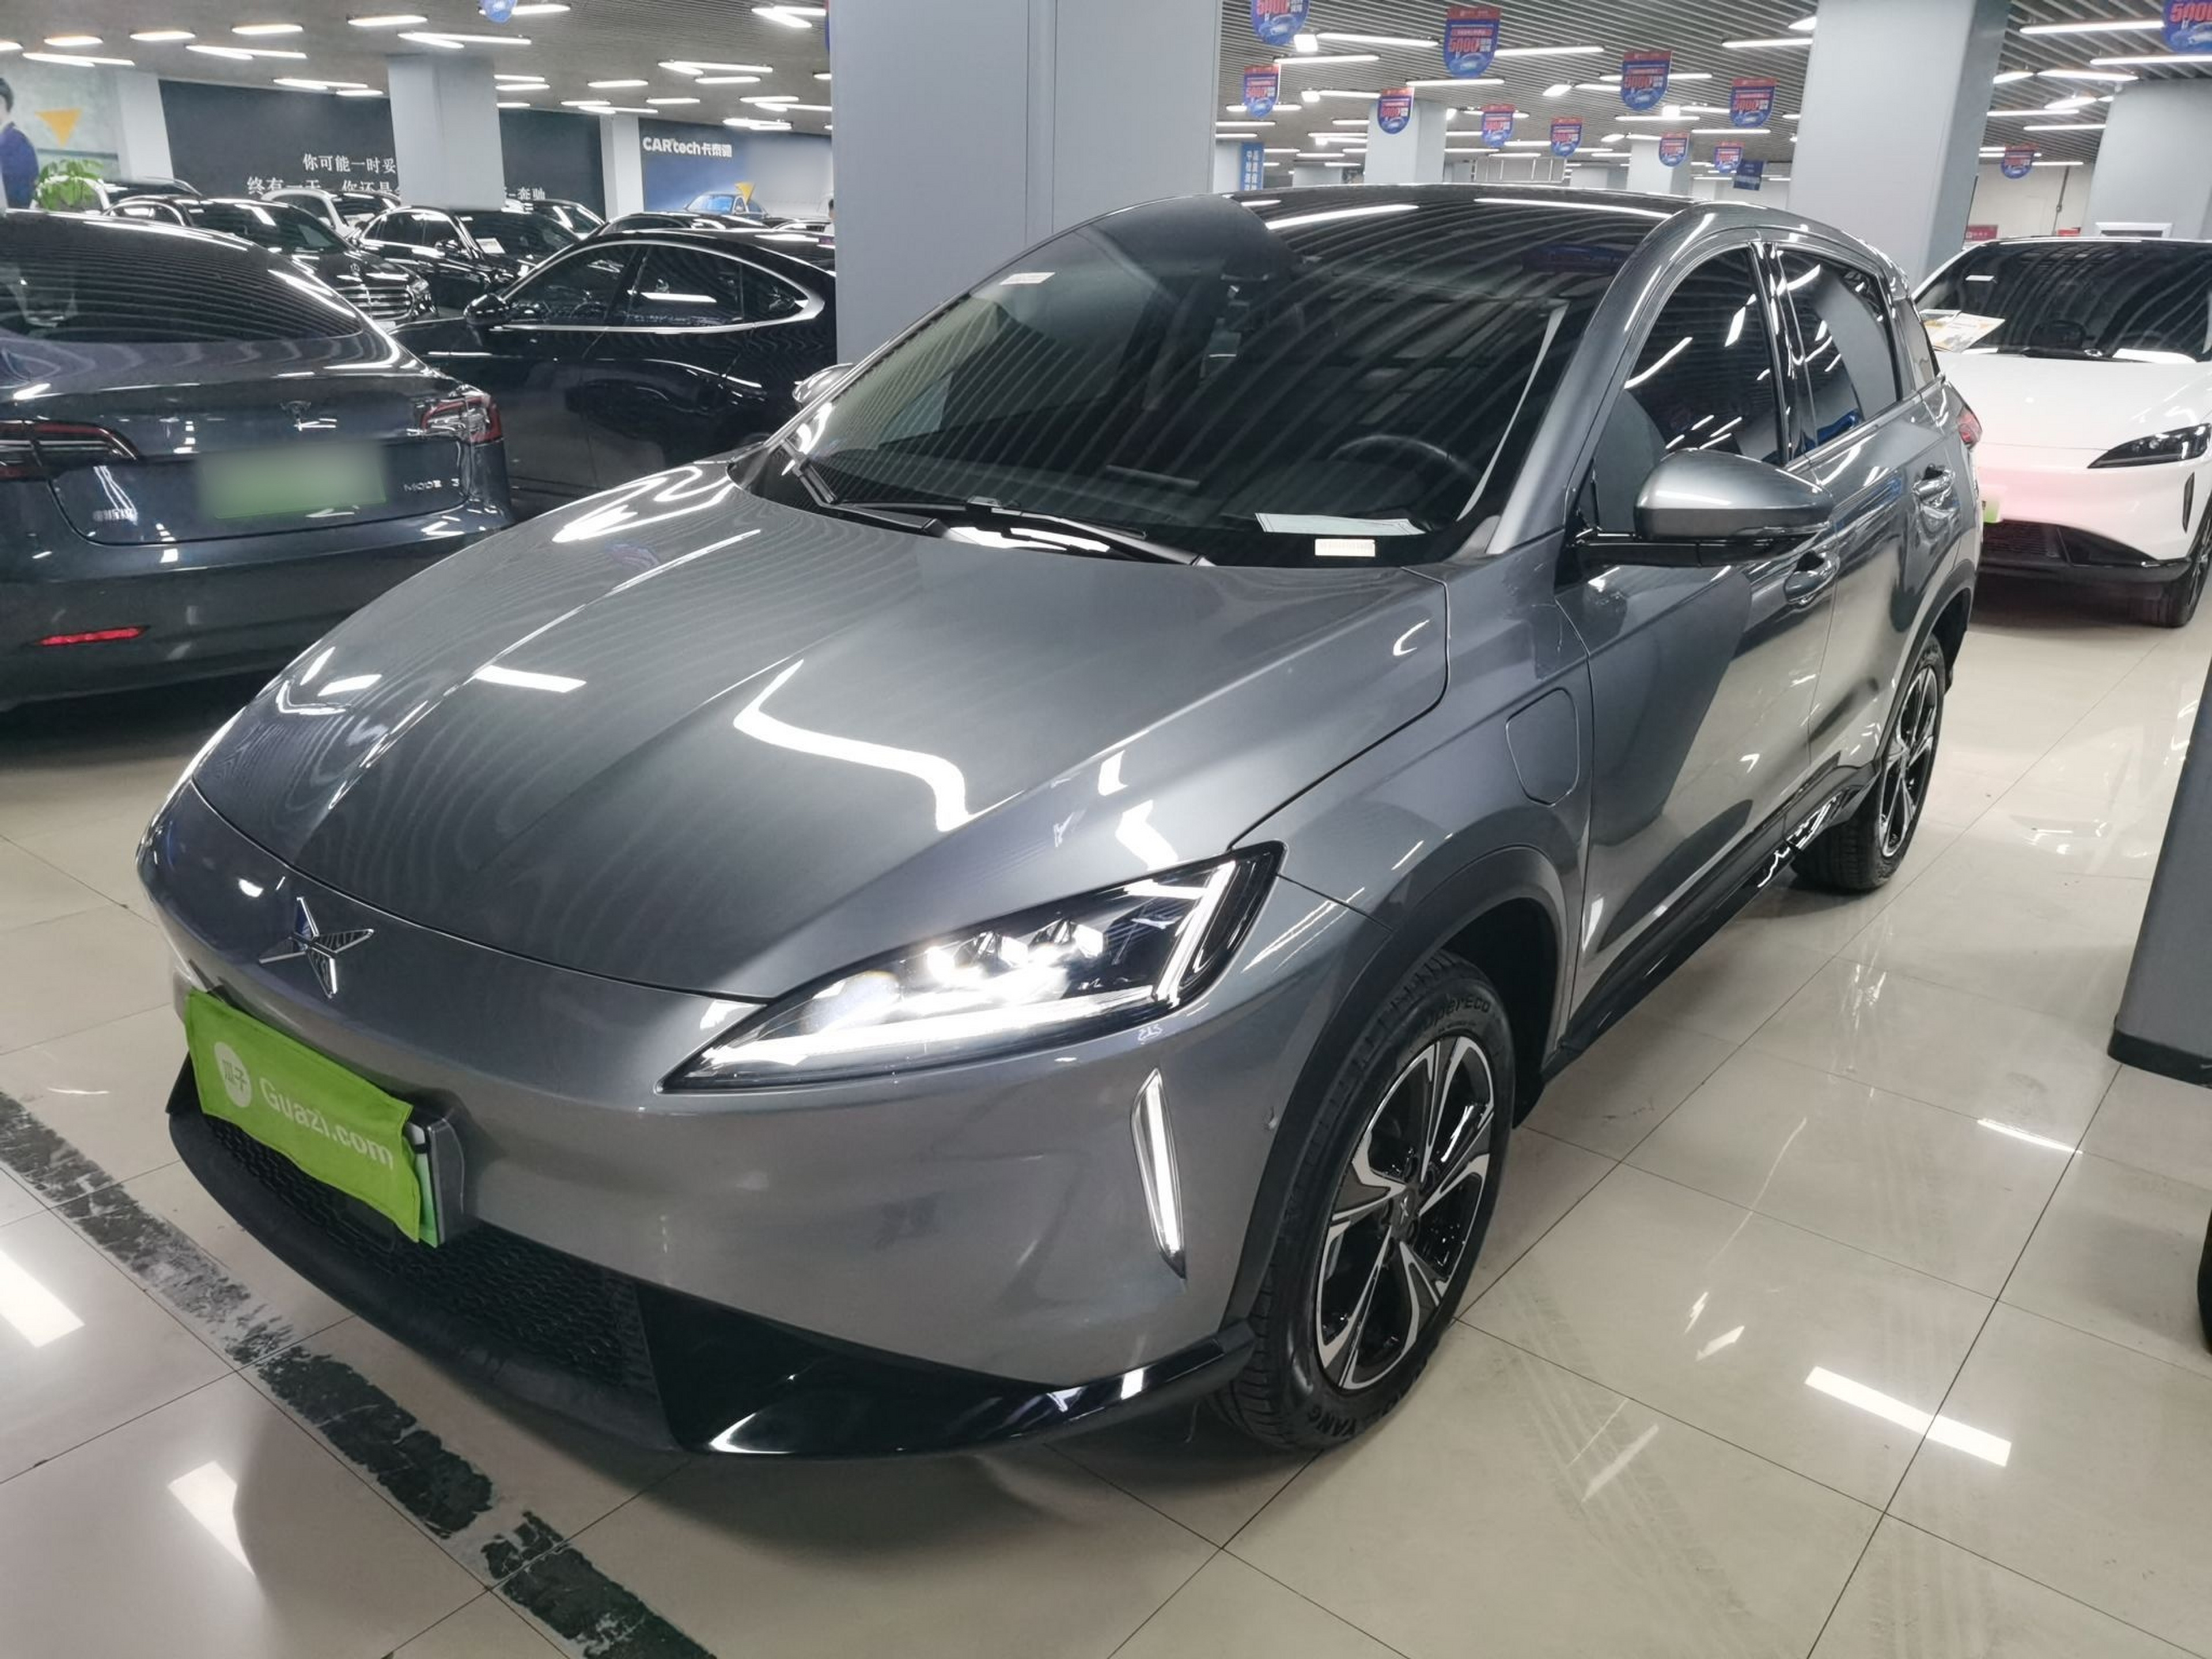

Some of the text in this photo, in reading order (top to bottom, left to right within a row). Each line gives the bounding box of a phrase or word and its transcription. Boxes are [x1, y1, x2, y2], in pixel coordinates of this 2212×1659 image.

[302, 153, 396, 173] 你可能一时妥
[259, 1077, 394, 1171] Guazi.com
